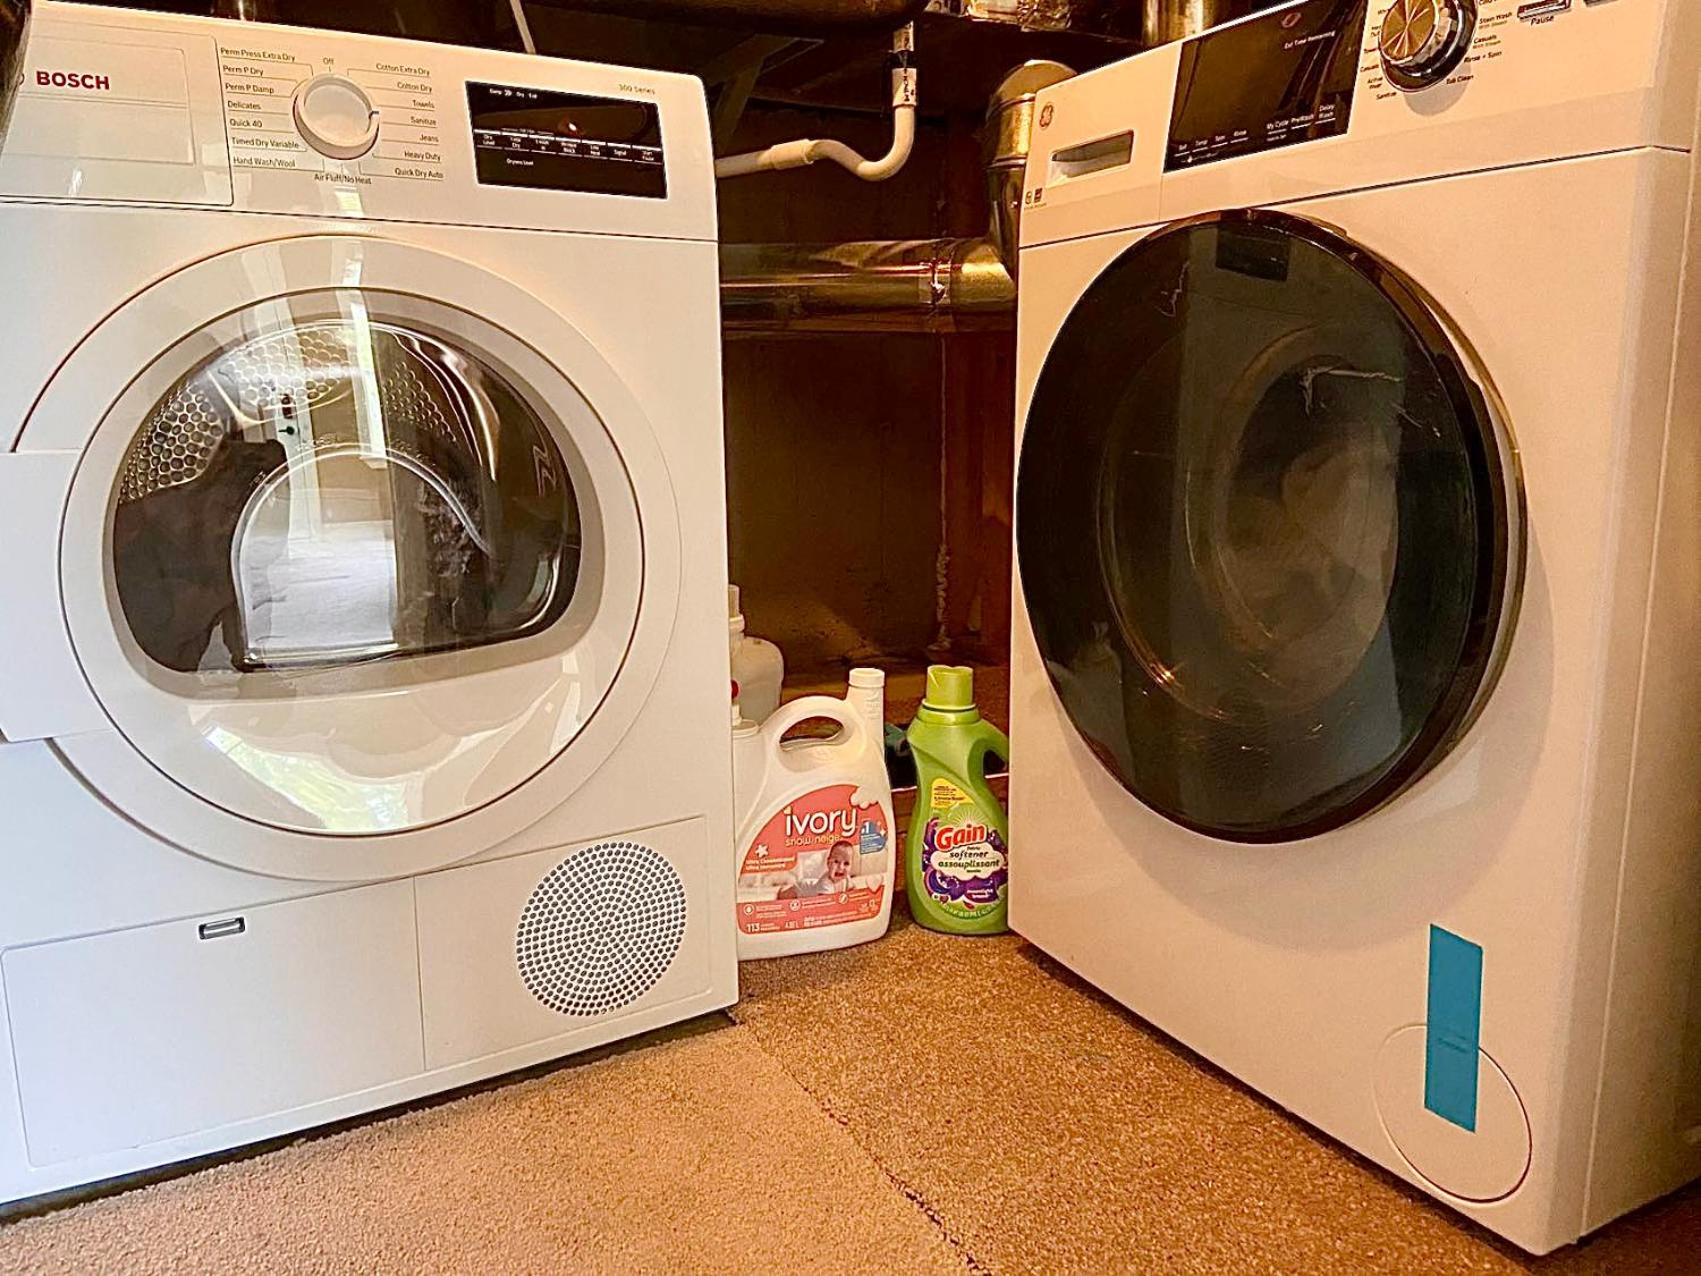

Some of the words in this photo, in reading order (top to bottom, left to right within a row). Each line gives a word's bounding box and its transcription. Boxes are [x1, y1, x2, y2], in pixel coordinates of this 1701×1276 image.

[1530, 15, 1554, 26] Pause
[221, 47, 240, 55] Perm
[241, 49, 261, 57] Press
[262, 51, 281, 59] Extra
[282, 53, 295, 63] Dry
[323, 57, 334, 65] Off
[223, 65, 242, 73] Perm
[250, 67, 264, 77] Dry
[376, 63, 399, 72] Cotton
[400, 65, 416, 73] Extra
[418, 67, 430, 77] Dry
[36, 70, 110, 90] BOSCH
[1457, 74, 1474, 83] Clean
[225, 82, 245, 91] Perm
[252, 85, 274, 96] Damp
[397, 82, 419, 90] Cotton
[420, 84, 432, 93] Dry
[634, 86, 655, 95] Series
[227, 101, 261, 110] Delicates
[413, 99, 435, 108] Towels
[230, 118, 251, 127] Quick
[252, 120, 262, 128] 40
[410, 116, 437, 125] Sanitize
[232, 137, 254, 145] Timed
[256, 138, 268, 148] Dry
[270, 139, 299, 148] Variable
[420, 134, 439, 142] Jeans
[404, 150, 425, 160] Heavy
[425, 152, 441, 161] Duty
[233, 156, 252, 165] Hand
[254, 157, 295, 167] Wash/Wool
[314, 173, 324, 181] Air
[356, 176, 372, 185] Heat
[395, 168, 414, 176] Quick
[415, 169, 427, 178] Dry
[428, 170, 444, 179] Auto
[783, 805, 857, 837] ivory
[785, 838, 812, 847] snow
[815, 834, 841, 846] neige
[936, 823, 985, 851] Gain
[950, 850, 989, 861] softener
[938, 860, 1001, 870] assouplissant
[745, 923, 761, 932] 113
